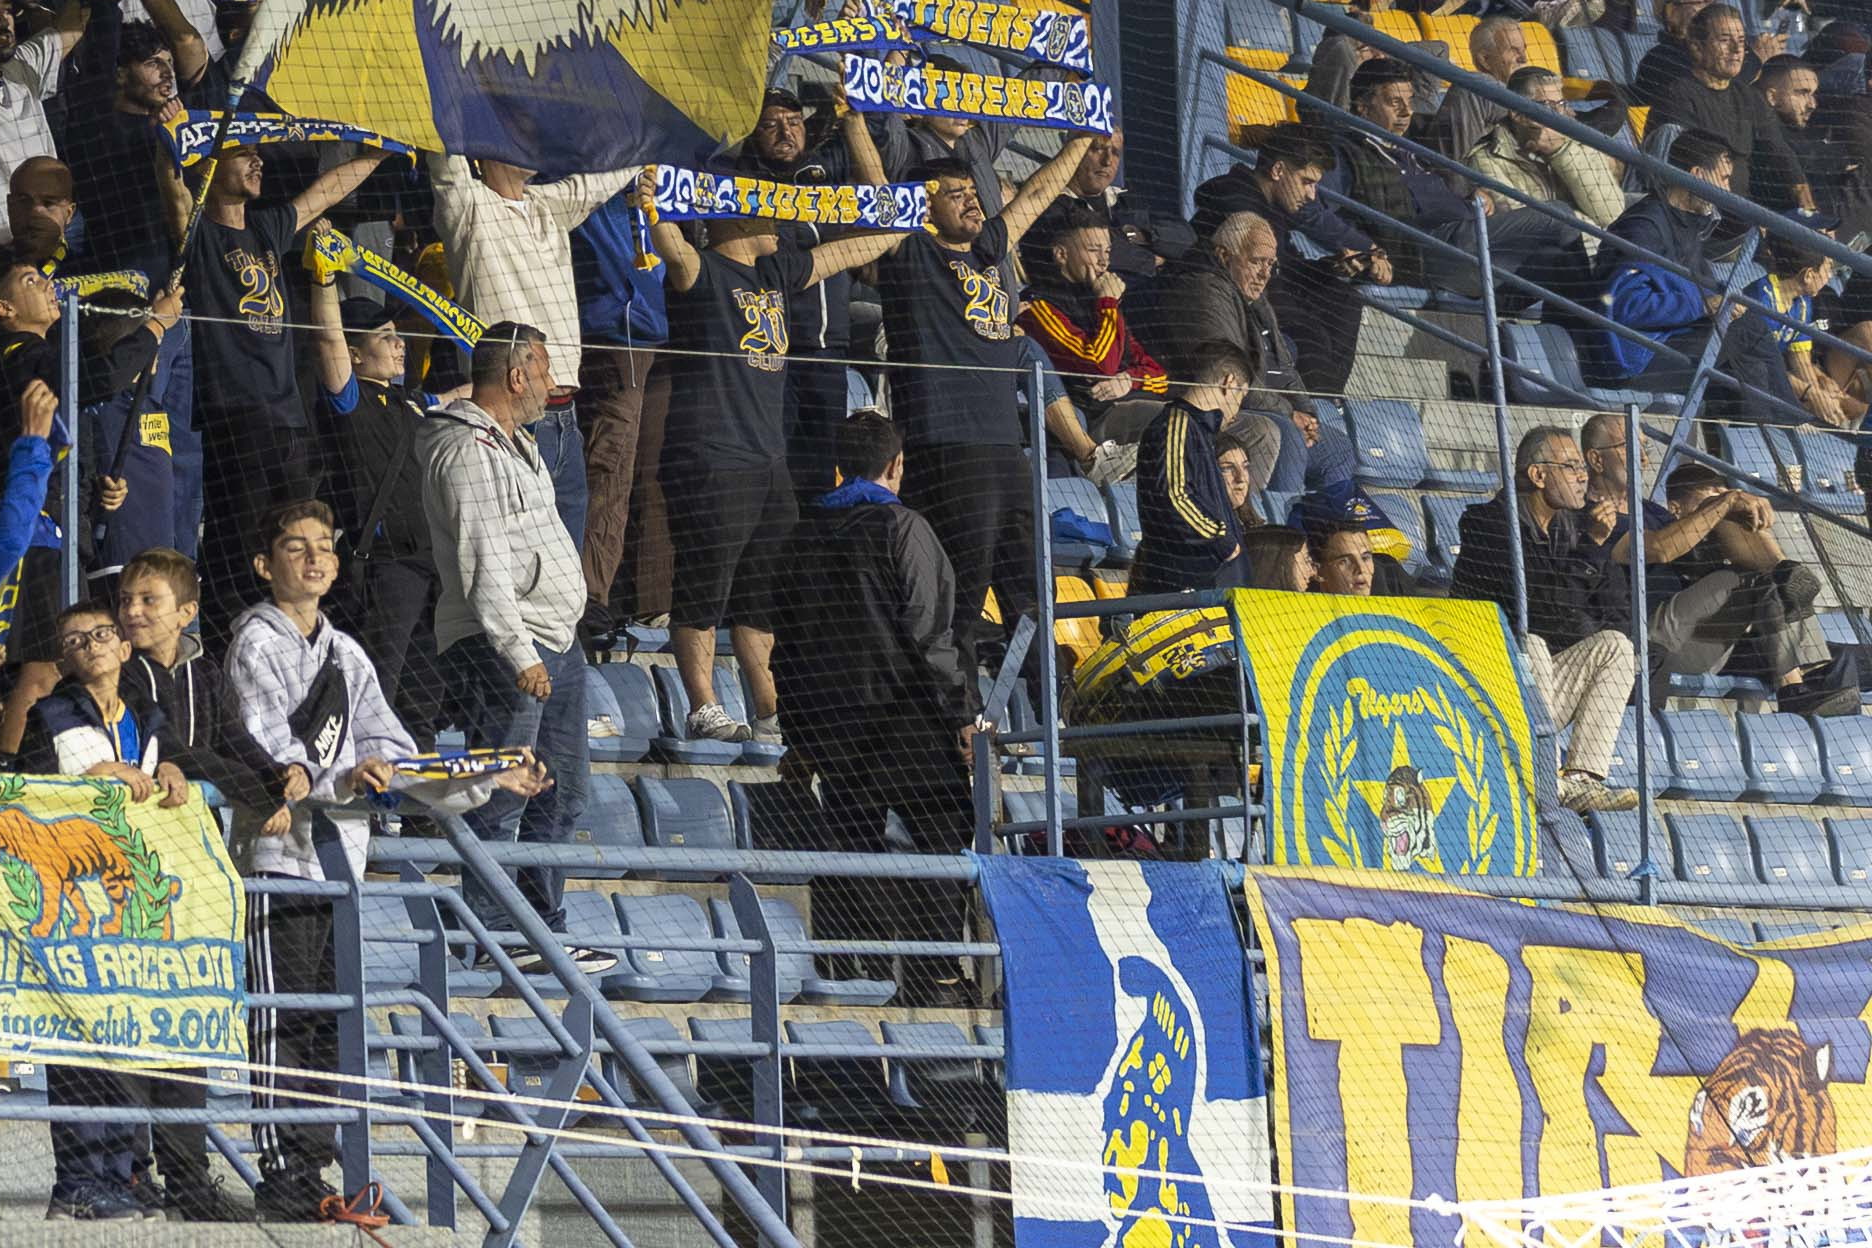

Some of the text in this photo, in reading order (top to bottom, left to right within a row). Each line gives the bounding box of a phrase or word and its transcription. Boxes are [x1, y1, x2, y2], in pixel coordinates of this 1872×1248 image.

[922, 63, 1047, 119] TIGERS
[733, 176, 862, 224] TIGERS
[1346, 677, 1424, 729] Tigers
[314, 713, 338, 758] NIKE
[43, 944, 89, 989] IS
[92, 1004, 142, 1049] club
